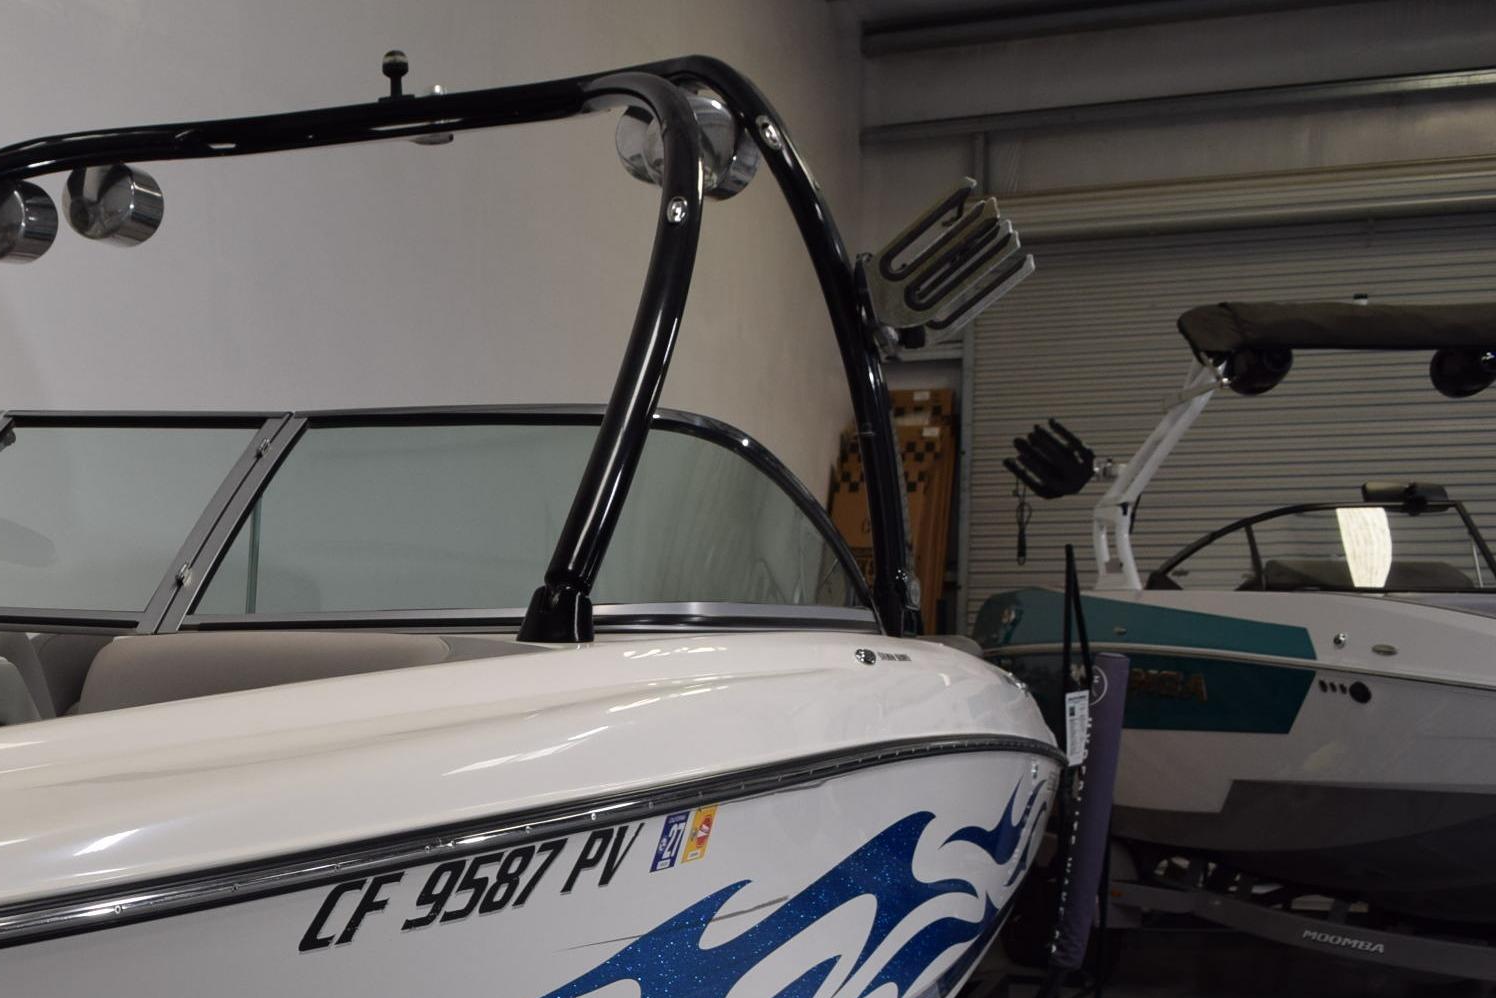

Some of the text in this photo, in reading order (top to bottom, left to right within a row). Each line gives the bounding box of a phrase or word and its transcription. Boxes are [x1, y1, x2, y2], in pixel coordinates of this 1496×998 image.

[661, 822, 686, 859] 27
[298, 822, 645, 952] CF 9587 PV
[1301, 929, 1385, 954] MOOMBA
